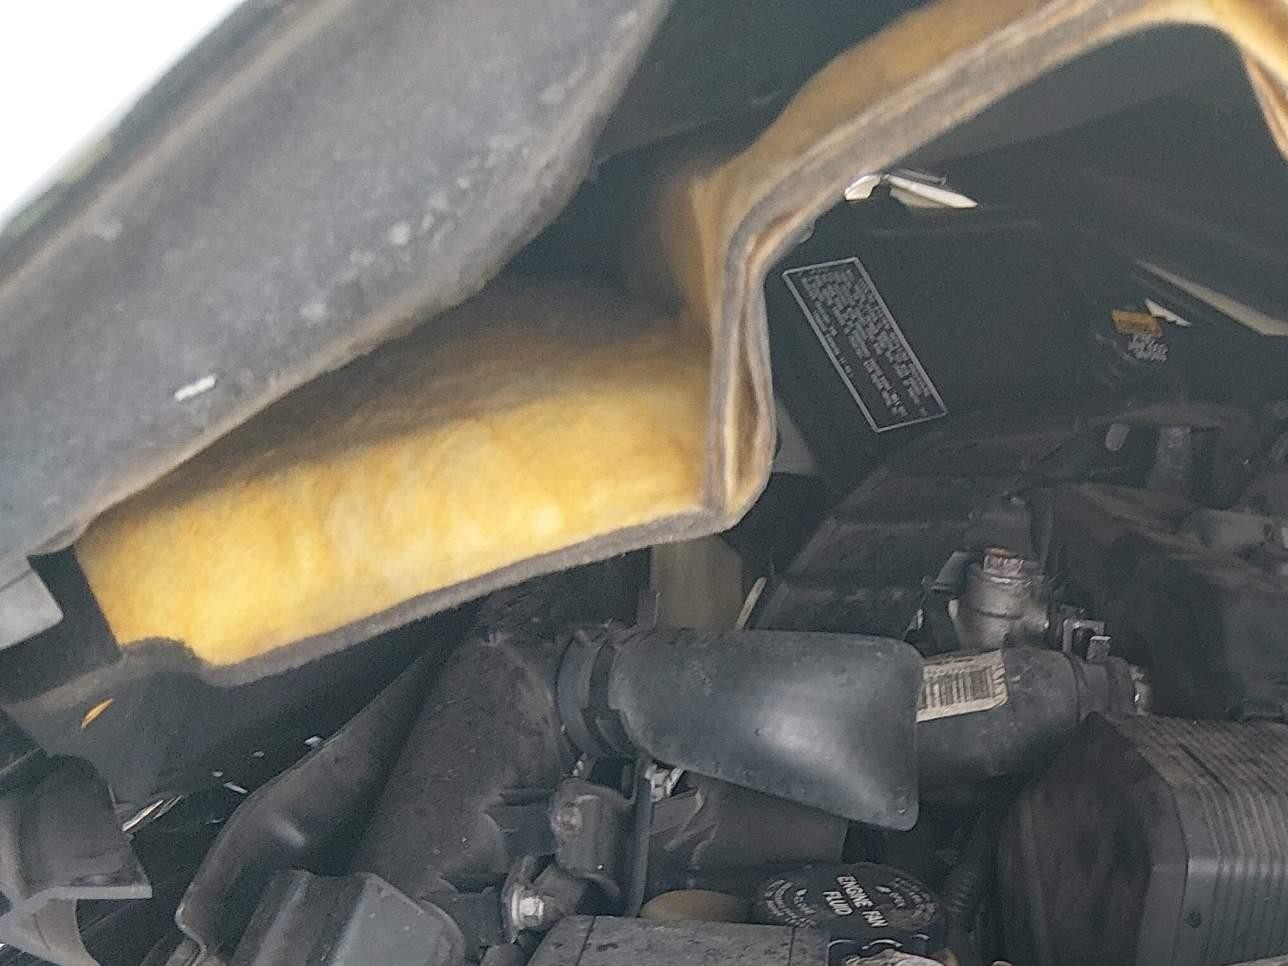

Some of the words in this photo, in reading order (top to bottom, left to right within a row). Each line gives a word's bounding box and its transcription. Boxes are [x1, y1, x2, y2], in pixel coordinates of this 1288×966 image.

[822, 891, 854, 916] FLUID
[836, 875, 875, 908] ENGINE
[862, 910, 890, 928] FAN
